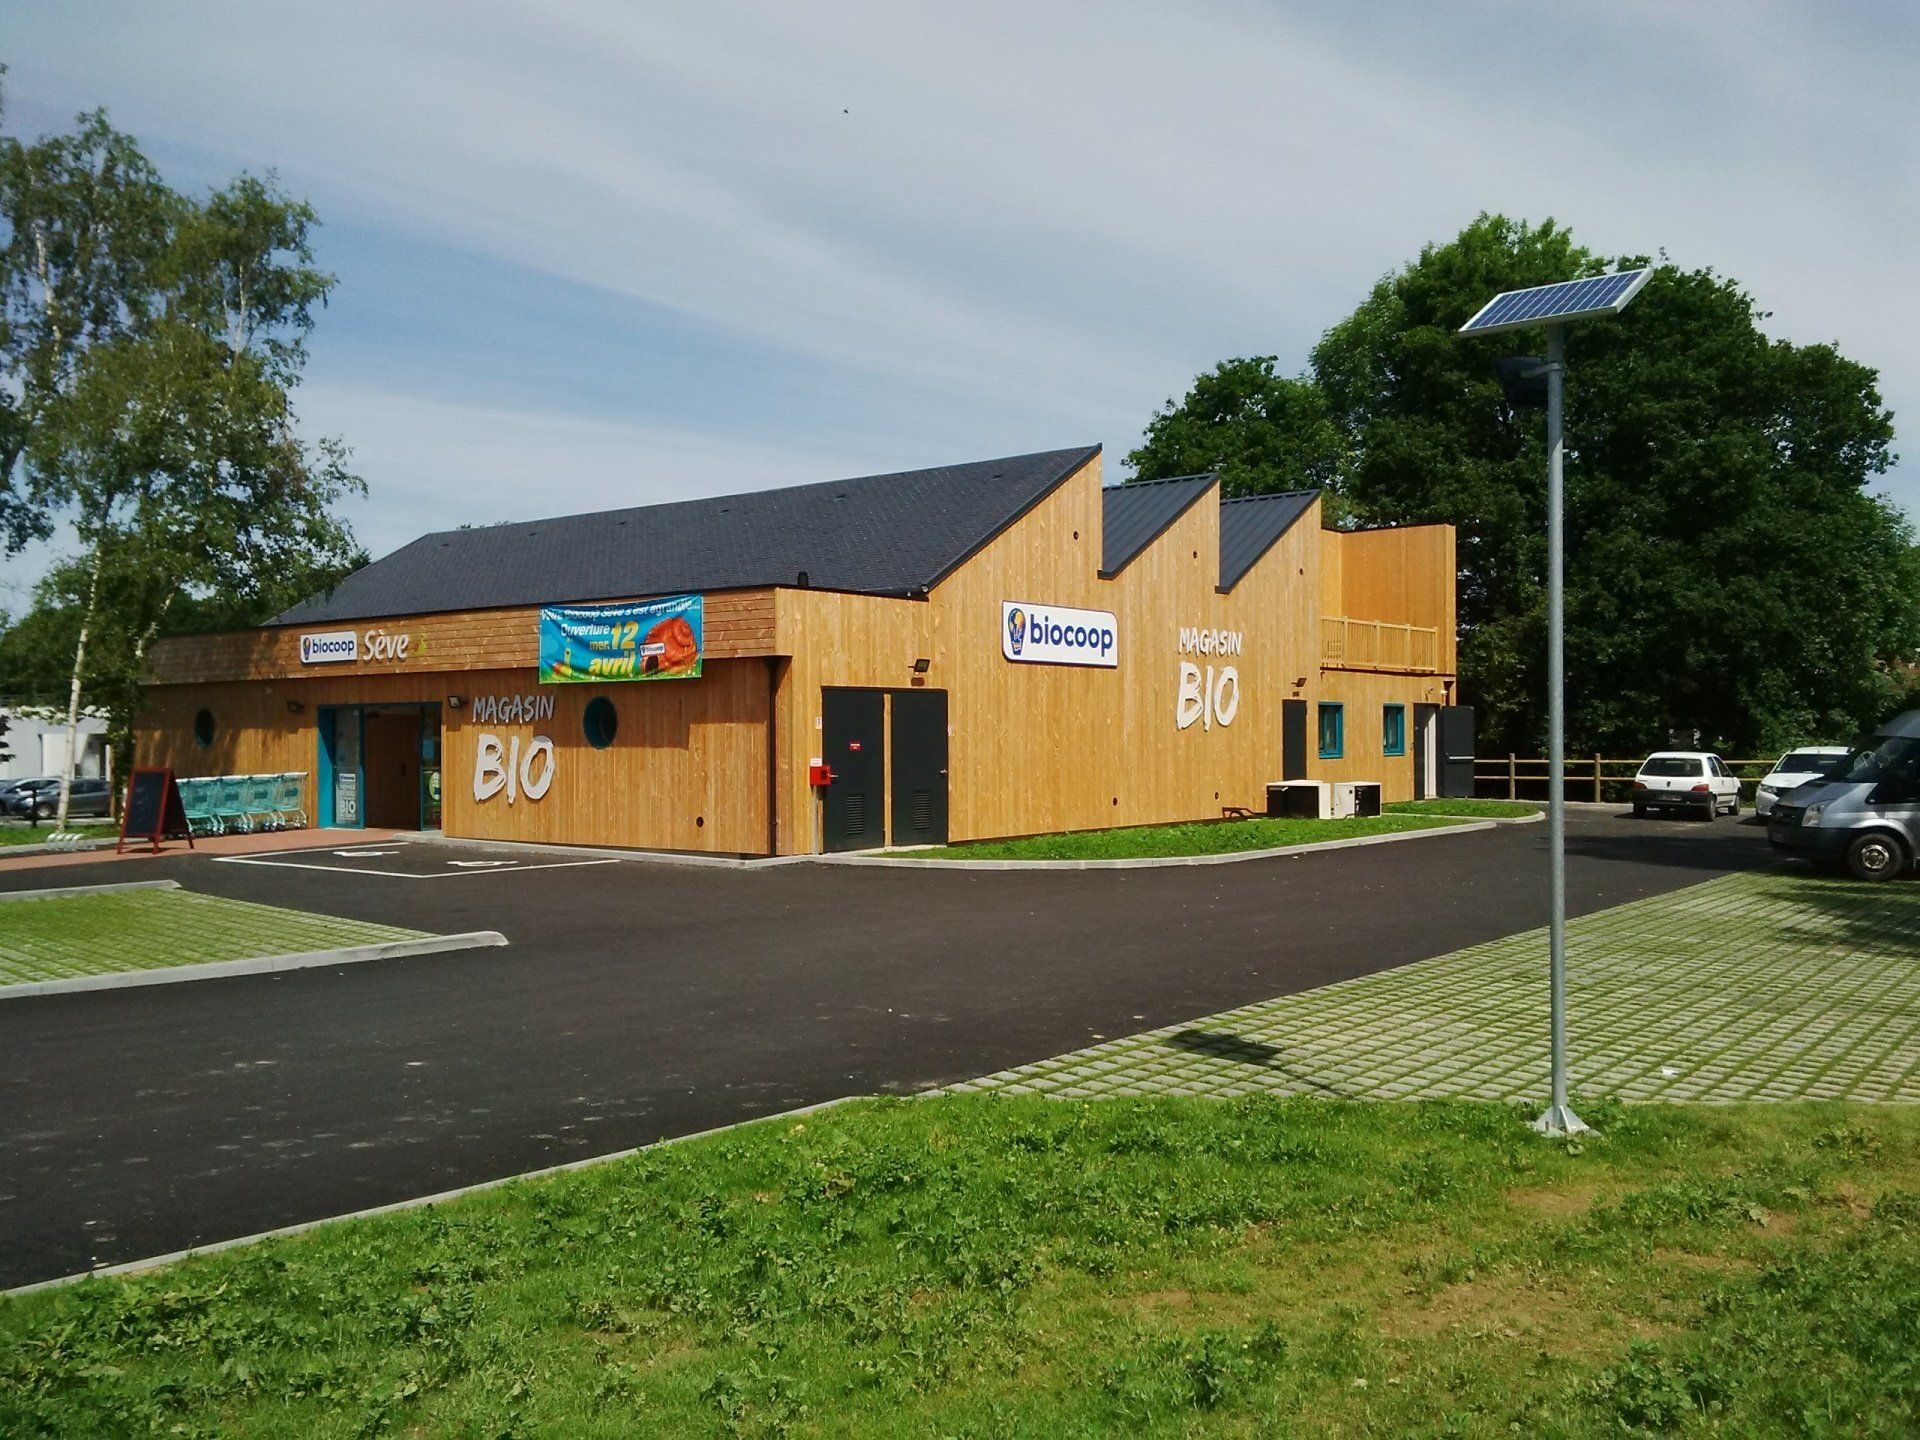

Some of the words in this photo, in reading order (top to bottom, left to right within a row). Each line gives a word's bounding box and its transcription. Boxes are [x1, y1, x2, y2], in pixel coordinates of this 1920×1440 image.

[312, 638, 355, 656] biocoop
[363, 629, 409, 660] Sève
[561, 623, 610, 637] Ouverture
[611, 621, 639, 649] 12
[1030, 614, 1113, 657] biocoop
[1178, 626, 1242, 658] MAGASIN
[588, 649, 636, 676] avril
[472, 694, 555, 724] MAGASIN
[1176, 660, 1240, 731] BIO
[473, 733, 556, 804] BIO
